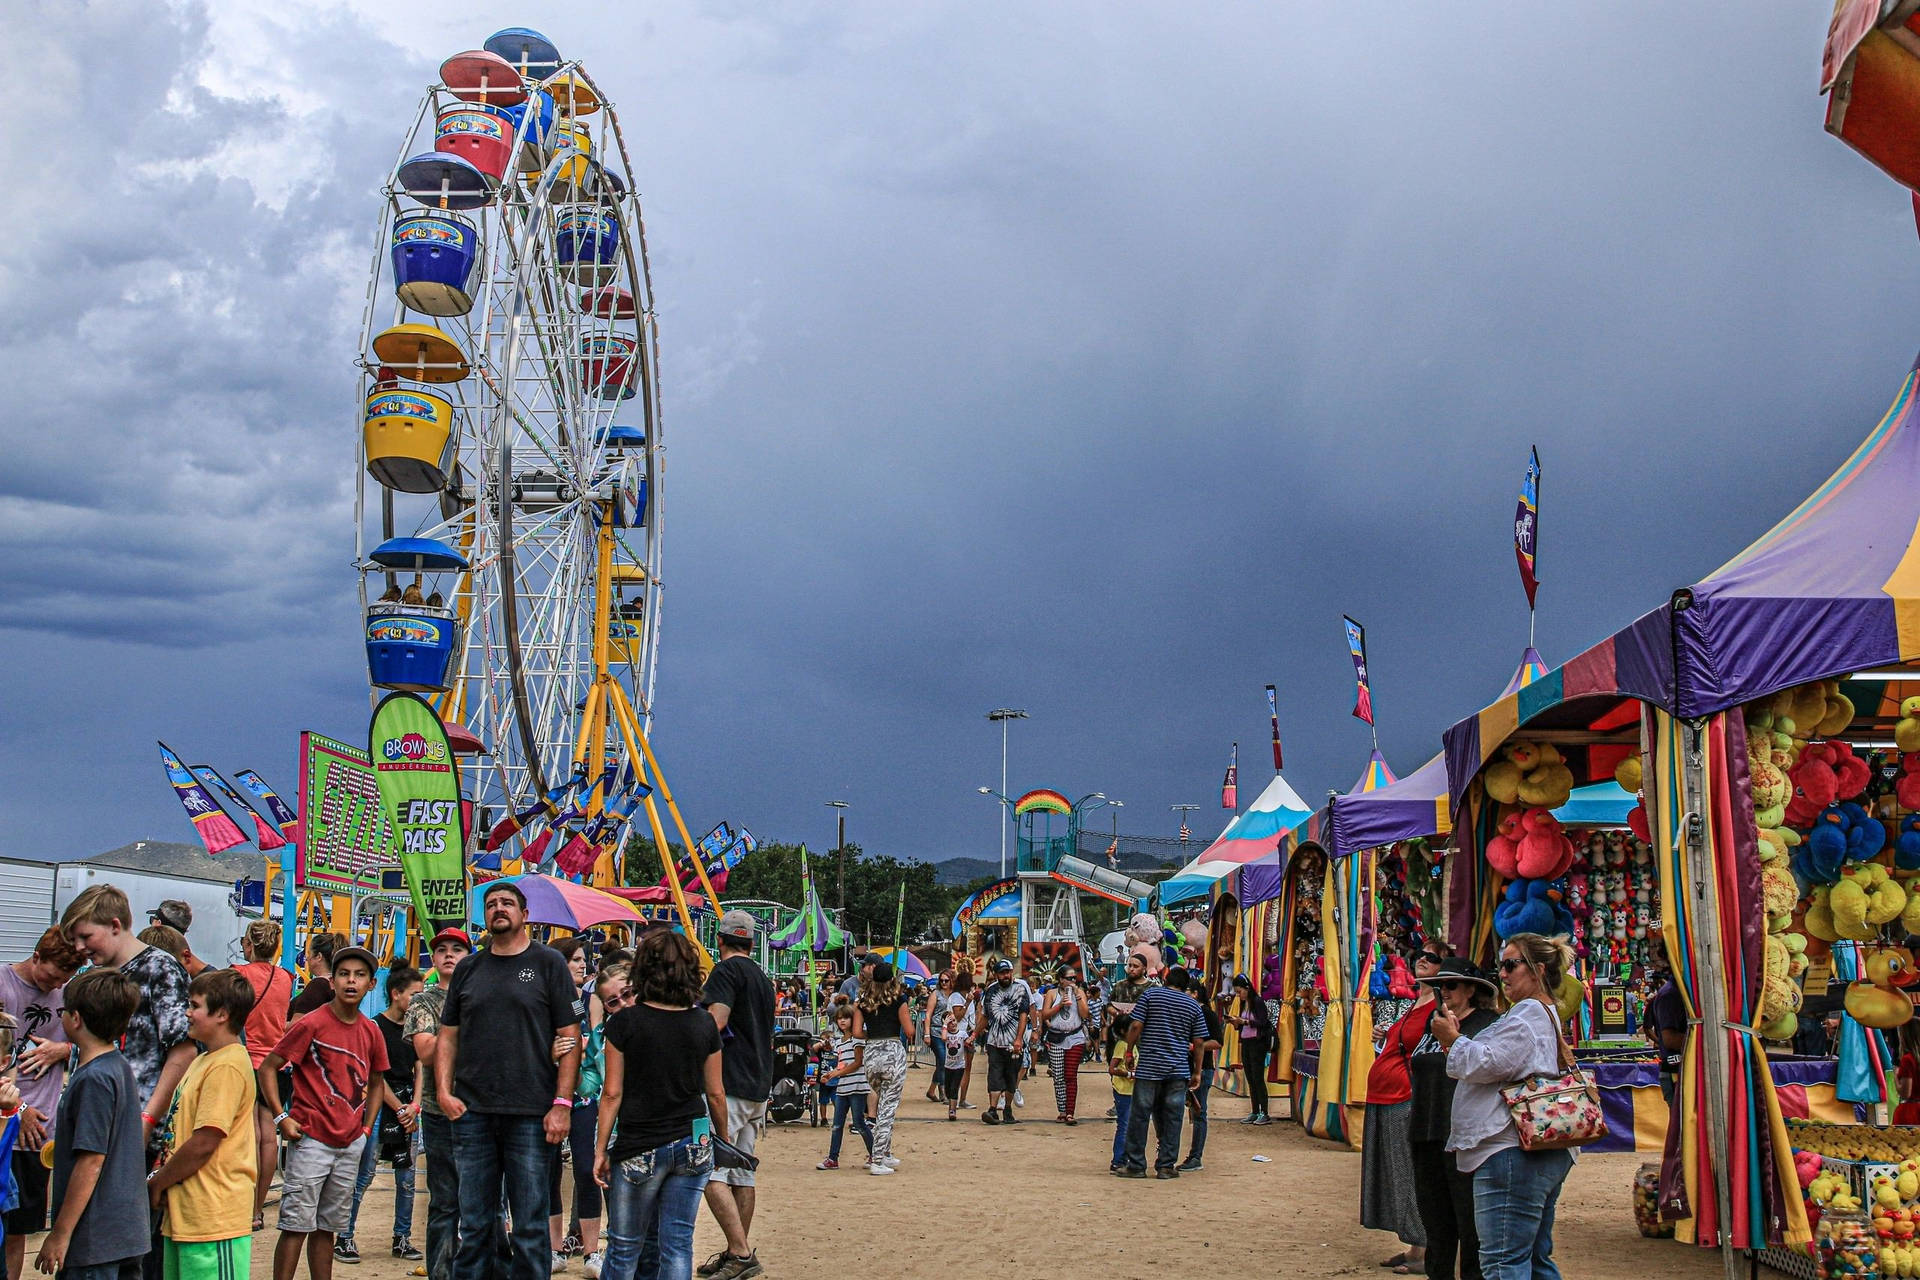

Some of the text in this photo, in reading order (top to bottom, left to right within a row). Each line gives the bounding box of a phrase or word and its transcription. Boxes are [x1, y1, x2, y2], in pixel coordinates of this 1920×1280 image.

[386, 738, 445, 758] BROWN'S
[315, 761, 401, 878] SIZZLE
[406, 800, 457, 825] FAST
[403, 828, 447, 853] PASS
[421, 879, 464, 896] ENTER
[425, 898, 464, 915] HRE!
